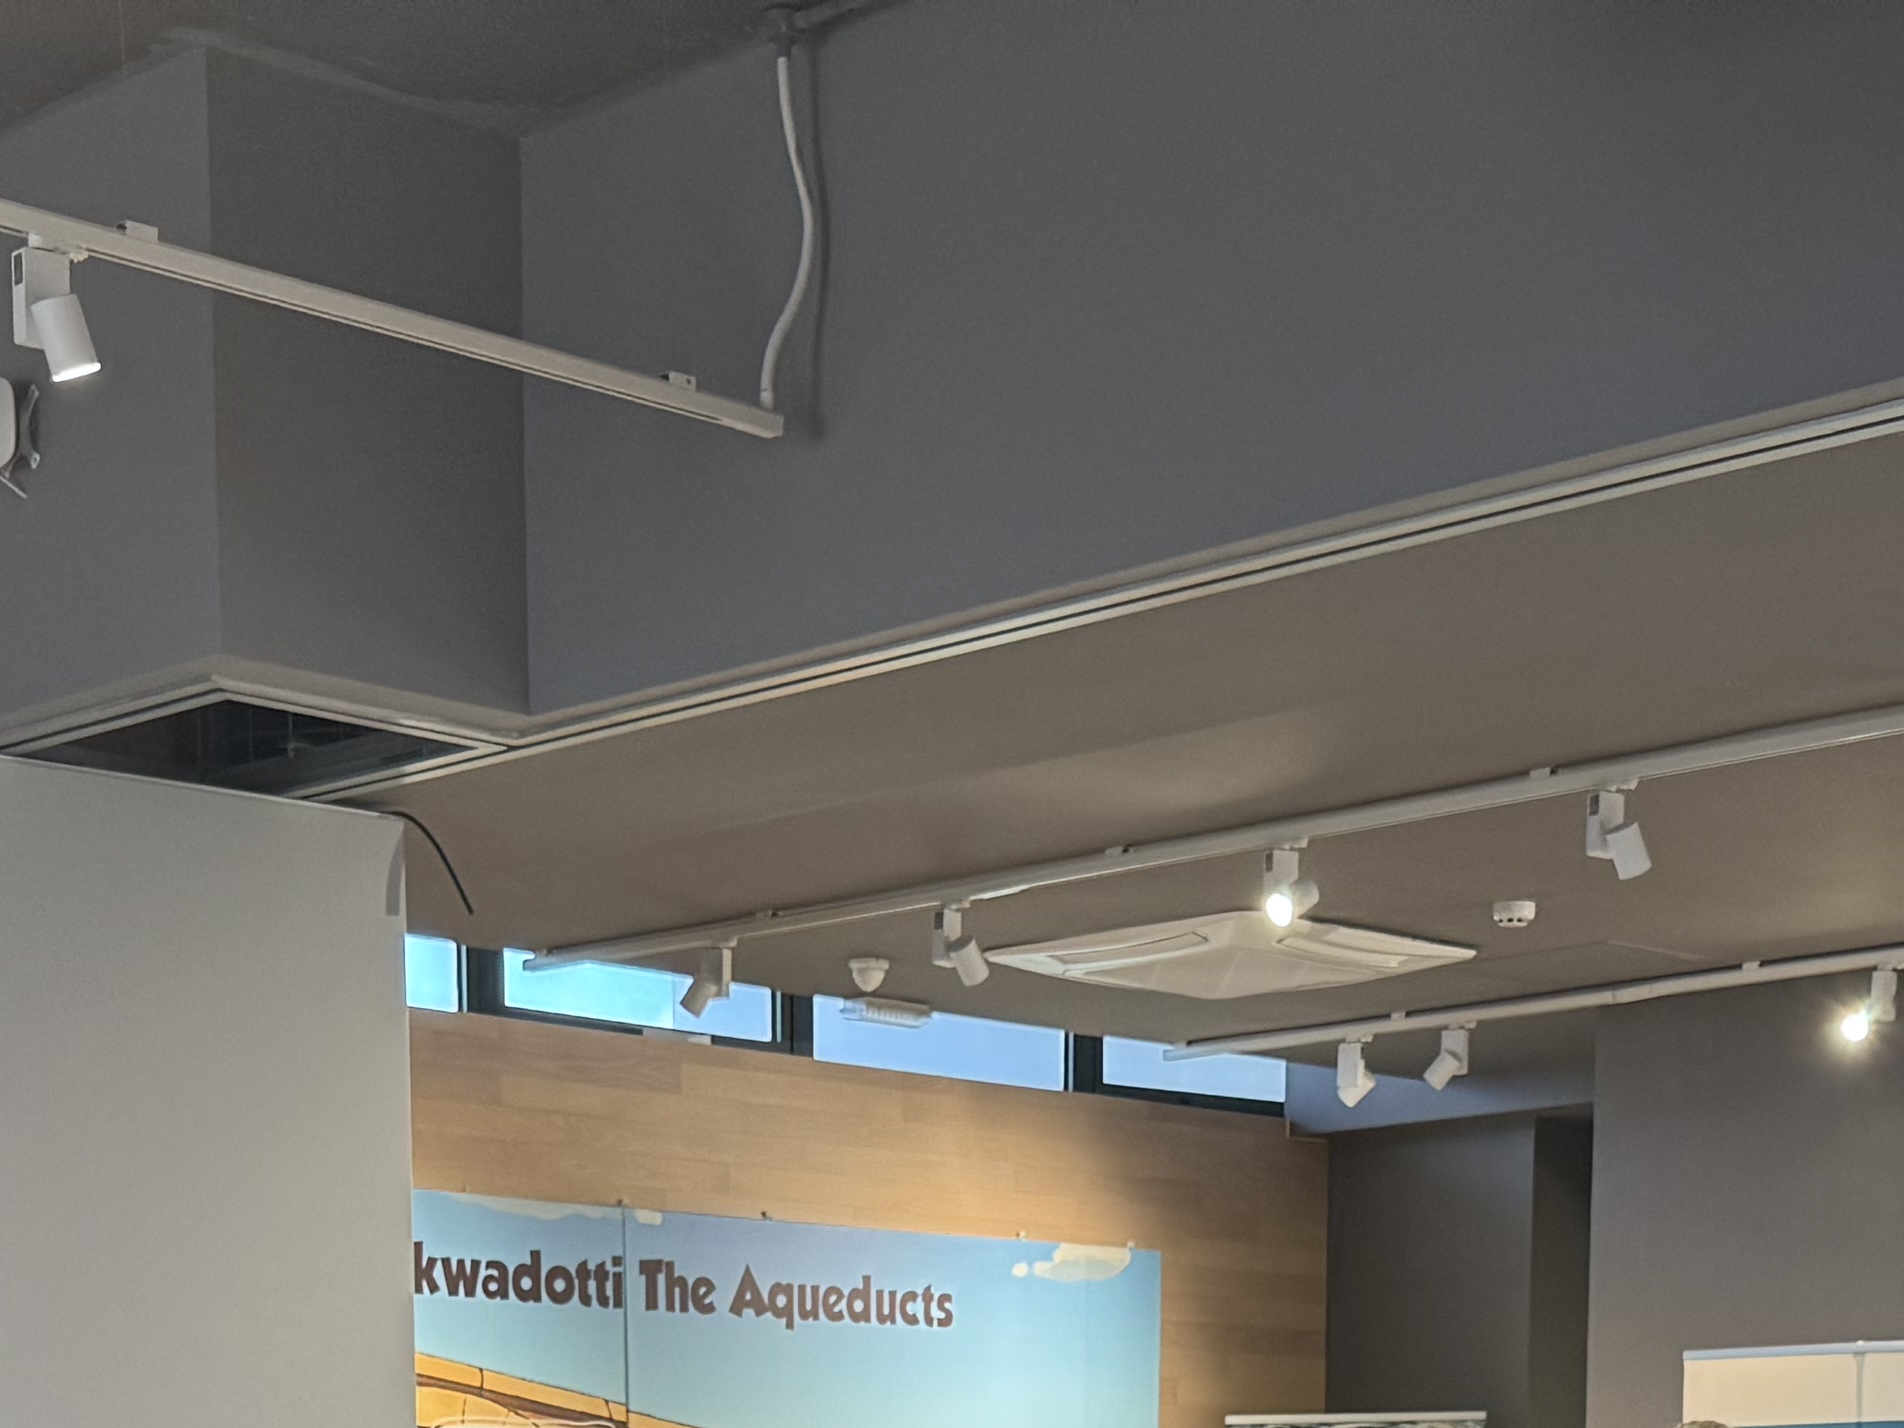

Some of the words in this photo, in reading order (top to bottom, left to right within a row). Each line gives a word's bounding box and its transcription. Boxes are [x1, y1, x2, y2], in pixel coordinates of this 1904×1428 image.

[413, 1240, 623, 1309] kwadotti
[639, 1259, 716, 1315] The
[728, 1264, 954, 1330] Aqueducts
